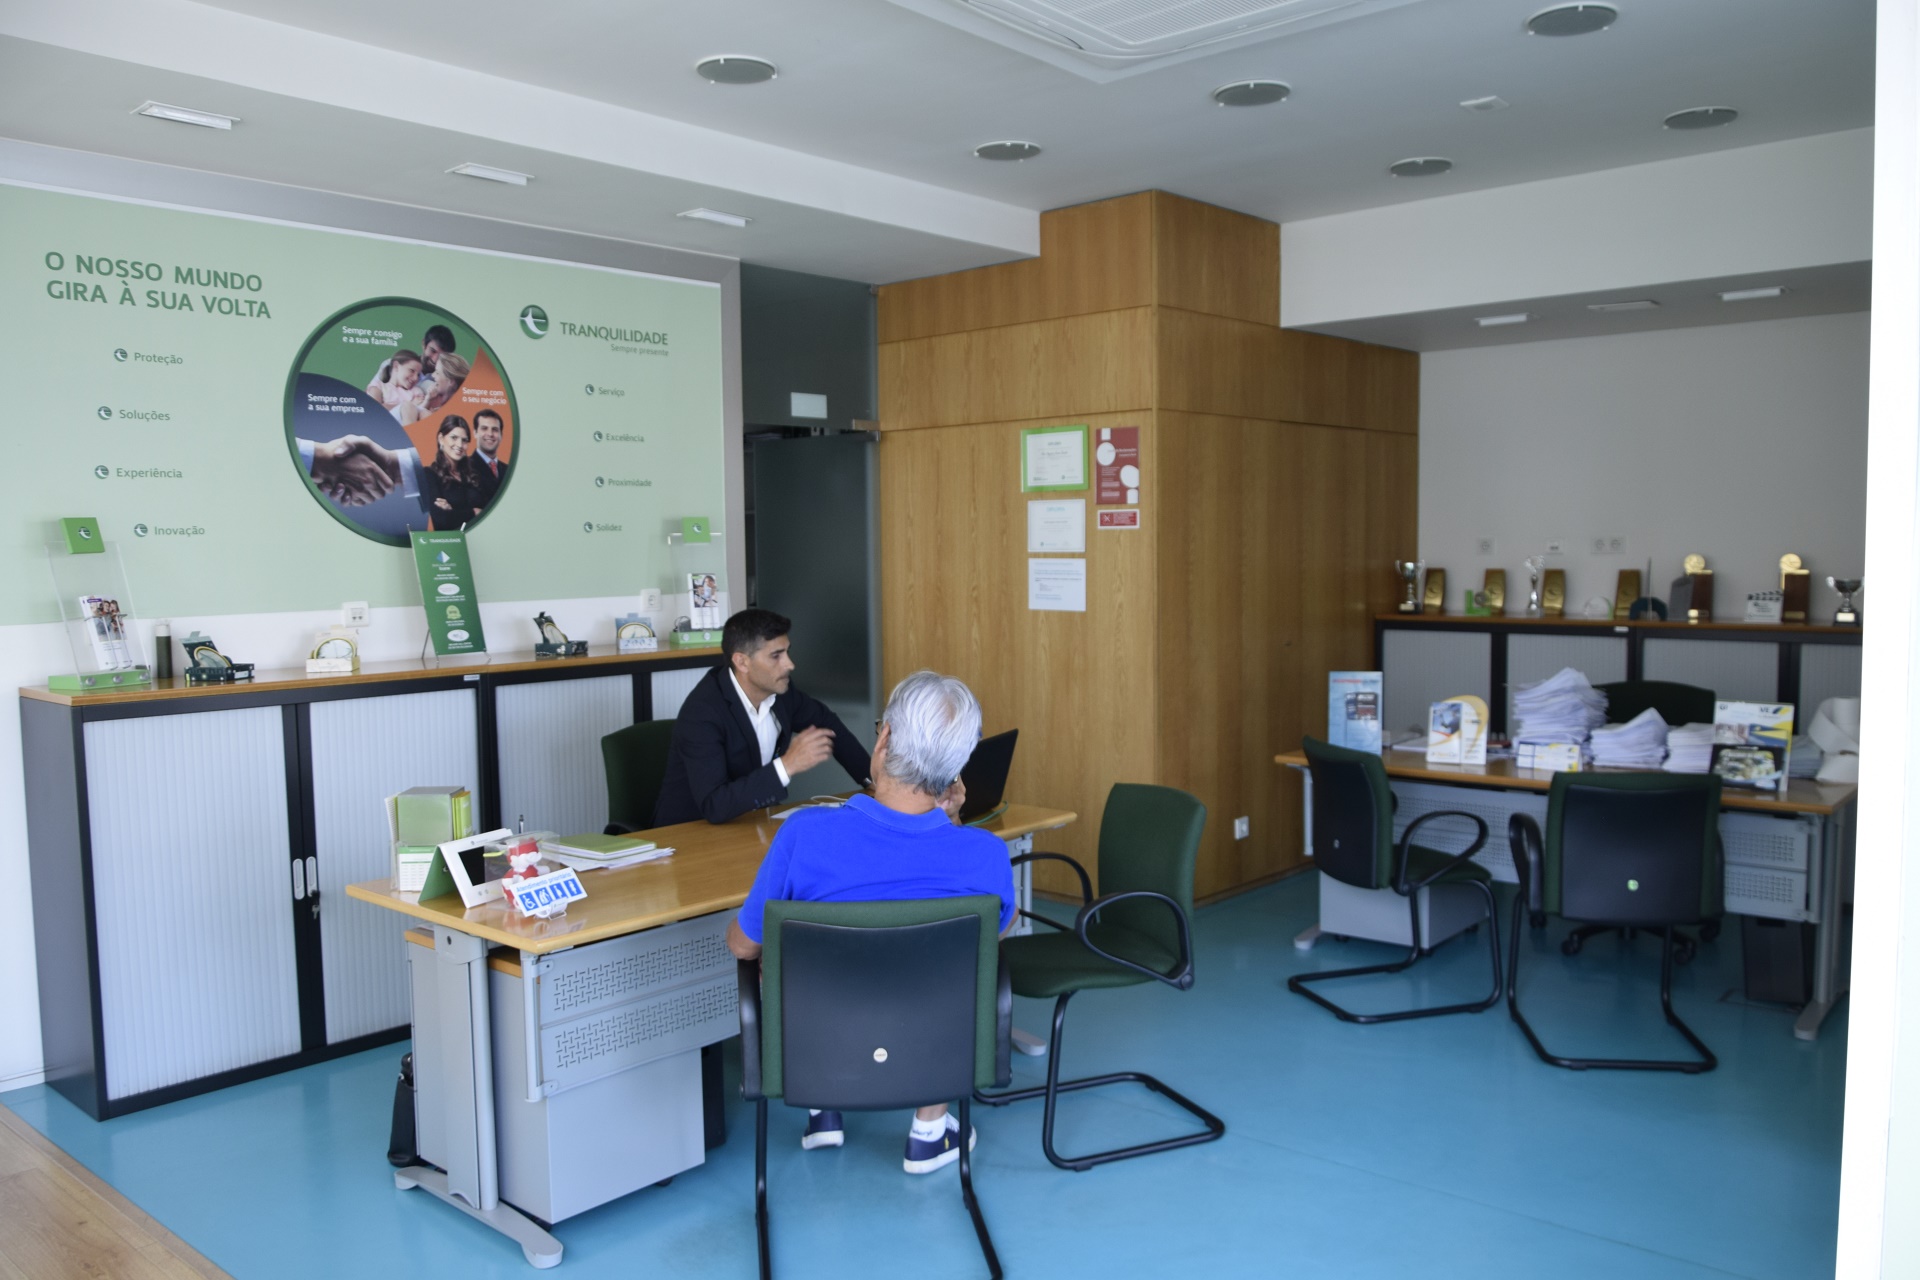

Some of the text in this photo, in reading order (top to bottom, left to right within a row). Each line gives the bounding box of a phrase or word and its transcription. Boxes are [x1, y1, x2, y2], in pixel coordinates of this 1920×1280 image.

[45, 251, 262, 292] O NOSSO MUNDO
[46, 280, 271, 319] GIRA À SUA VOLTA
[342, 326, 403, 340] Sempre consigo
[560, 322, 668, 346] TRANQUILIDADE
[371, 336, 398, 347] família
[611, 344, 669, 357] Sempre presente
[134, 351, 183, 365] Proteção
[462, 387, 504, 397] Sempre com
[598, 387, 625, 397] Serviço
[308, 393, 357, 404] Sempre com
[481, 395, 507, 405] negócio
[119, 408, 171, 423] Soluções
[331, 405, 365, 414] empresa
[606, 433, 645, 443] Excelência
[116, 466, 183, 480] Experiência
[608, 478, 652, 488] Proximidade
[154, 524, 206, 538] Inovação
[596, 523, 622, 532] Solidez
